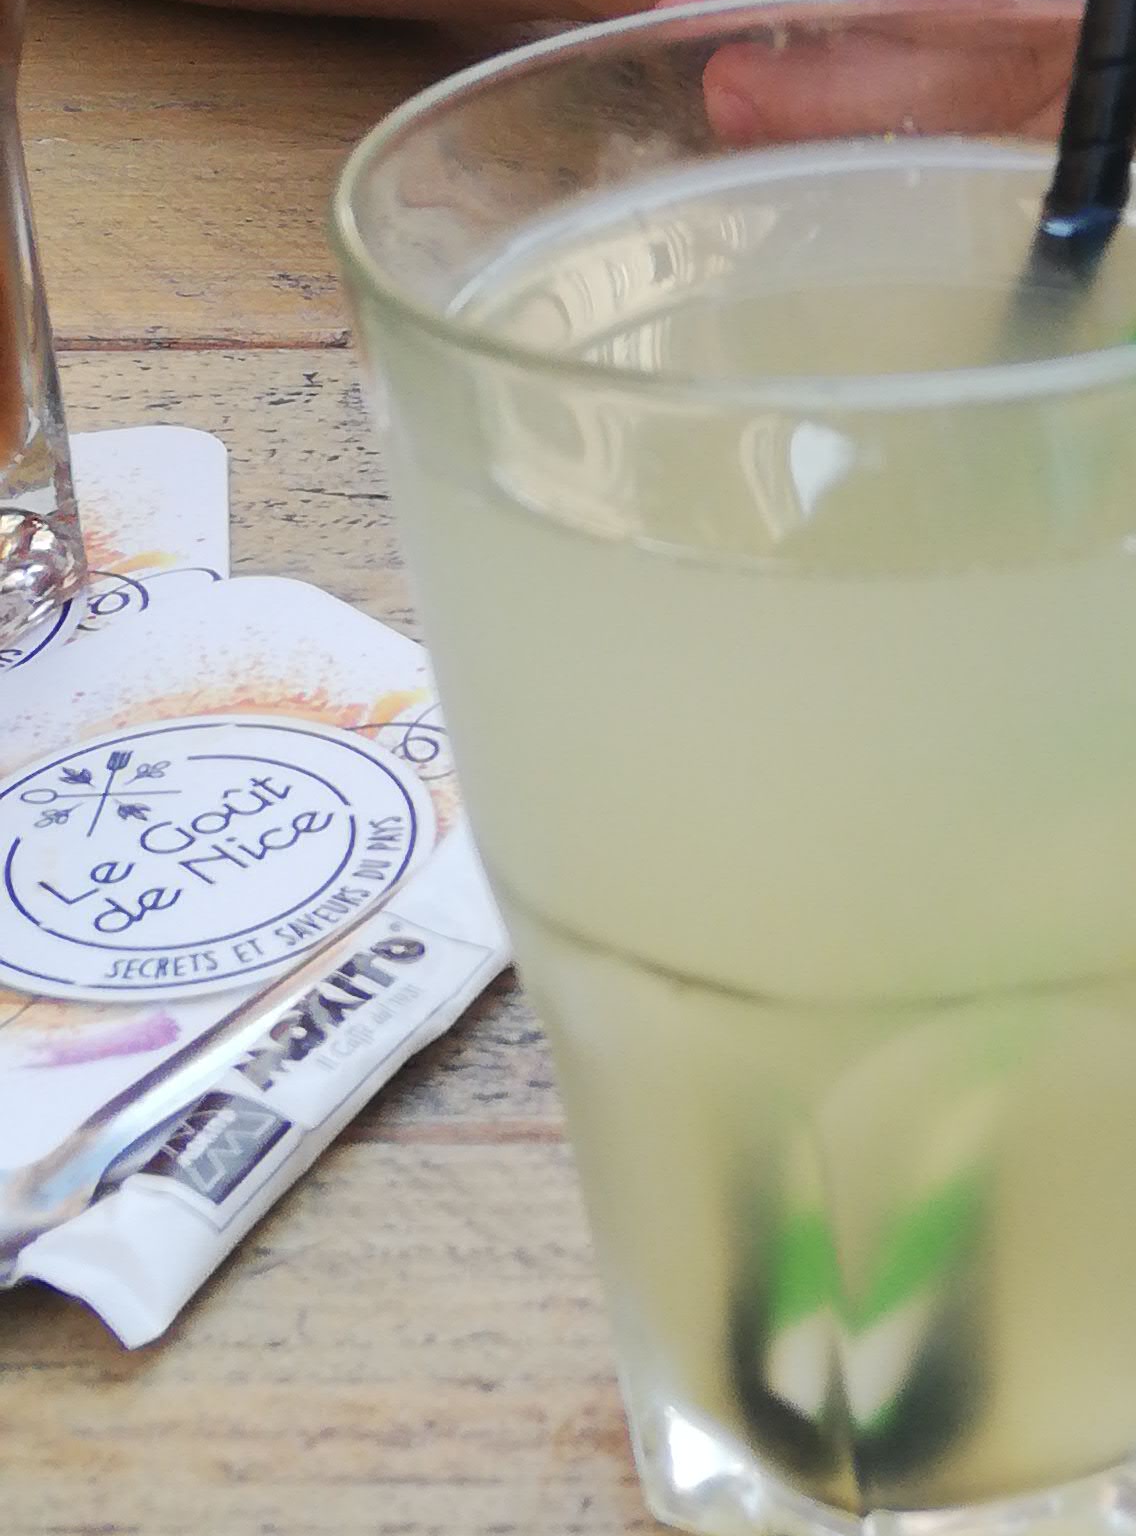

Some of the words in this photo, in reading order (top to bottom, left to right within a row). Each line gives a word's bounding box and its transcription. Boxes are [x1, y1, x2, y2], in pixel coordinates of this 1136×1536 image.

[37, 861, 135, 905] Le
[140, 776, 292, 854] Goût
[366, 816, 405, 850] PAYS
[94, 887, 183, 933] de
[178, 811, 336, 885] Nice
[352, 859, 393, 880] DU
[104, 951, 219, 980] SECRETS
[232, 938, 264, 964] ET
